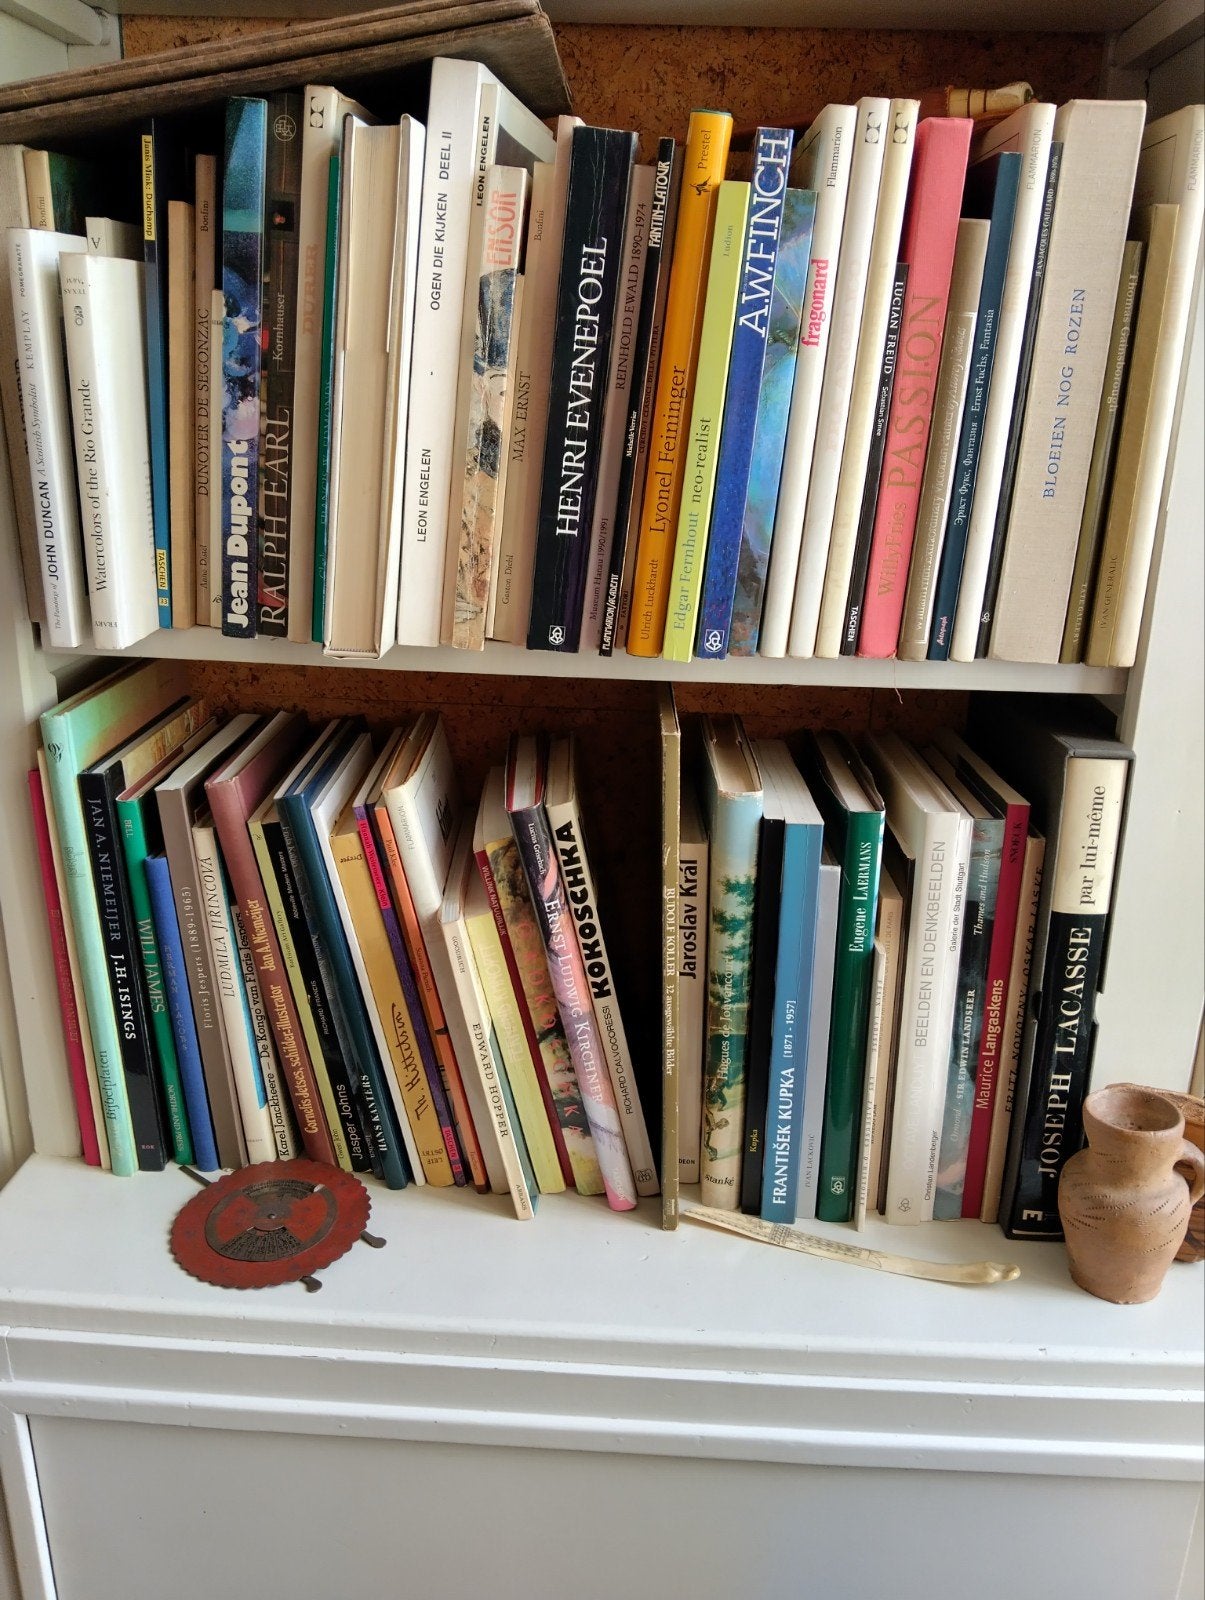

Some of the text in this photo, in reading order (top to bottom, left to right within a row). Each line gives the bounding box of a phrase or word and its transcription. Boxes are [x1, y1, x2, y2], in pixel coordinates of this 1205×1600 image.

[476, 117, 489, 206] LEON ENGELEN
[648, 161, 670, 247] FANTIN-LATOUR
[697, 129, 711, 170] Prestel
[826, 126, 842, 188] Flammarion
[1026, 129, 1042, 190] FLAMMARION
[1187, 129, 1204, 191] FLAMMARION
[430, 131, 452, 310] OGEN DIE KIJKEN DEEL II
[486, 190, 517, 265] ENSOR
[1035, 229, 1050, 277] JEAN-JACQUES
[21, 310, 34, 369] KEMPLAY
[273, 292, 285, 361] Kornhauser
[615, 265, 639, 390] REINHOLD EWALD
[801, 259, 829, 347] fragonard
[883, 282, 904, 374] LUCIAN FREUD
[1107, 273, 1139, 413] Thomas Gainsborough
[197, 309, 209, 496] DUNOYER DE SEGONZAC
[555, 237, 607, 537] HENRI EVENEPOEL
[887, 293, 941, 489] PASSION
[971, 309, 994, 411] Ernst Fuchs, Fantasia
[1043, 289, 1086, 498] BLOEIEN NOG ROZEN
[512, 371, 531, 462] MAX ERNST
[27, 383, 59, 581] JOHN DUNCAN Scottish Symbolist
[78, 379, 108, 591] Watercolors of the Rio Grande
[260, 408, 290, 626] RALPH EARL
[417, 449, 431, 542] LEON ENGELEN
[640, 366, 687, 640] Ulrich Luckhardt Lyonel Feininger
[673, 417, 711, 630] Edgar Fernhout neo-realist
[954, 422, 978, 526] Эрнст Фукс, Фантазия
[158, 552, 167, 588] TASCHEN
[226, 440, 252, 628] Jean Dupont
[589, 517, 608, 620] Museum Hanau 1990/1991
[847, 606, 859, 642] TASCHEN
[386, 840, 396, 852] Paul
[398, 806, 414, 849] FLAMMARION
[852, 842, 872, 900] LAERMANS
[1079, 786, 1106, 905] par lui-même
[87, 799, 136, 1039] JAN A. NIEMEIJER J.H. ISINGS
[197, 857, 235, 997] LUDMILA JIŘINCOVÁ
[481, 865, 507, 936] WILLINK NATUURLIJK
[679, 859, 698, 979] Jaroslav Král
[914, 841, 946, 1047] BEELDEN EN DENKBEELDEN
[973, 849, 991, 935] Thames and Hudson
[137, 919, 164, 1013] WILL JAMES
[181, 886, 213, 1028] Floris Jespers (1889-1965)
[277, 851, 363, 1160] Jasper Johns RICHARD FRANCIS Modern Masters
[528, 823, 603, 1102] Lucius ERNST LUDWIG KIRCHNER
[554, 821, 633, 1115] KOKOSCHKA RICHARD CALVOCORESSI
[665, 888, 676, 1075] RUDOLF Bilder
[240, 952, 290, 1156] Karel Jonckheere De van Floris
[246, 899, 318, 1133] Cornelis Jetses, schilder-illustrator Jan A. Niemeijer
[451, 936, 509, 1138] GOODRICH EDWARD HOPPER
[717, 1023, 731, 1080] Hugues de
[924, 863, 965, 1200] Christian Landenberger Galerie der Stadt Stuttgart
[956, 989, 976, 1099] SIR EDWIN LANDSEER
[976, 979, 1004, 1109] Maurice Langaskens
[1037, 927, 1092, 1178] JOSEPH LACASSE
[100, 1051, 119, 1120] Bijbelplaten
[361, 1074, 388, 1151] HANS KANTERS
[749, 1129, 759, 1152] Kupka
[773, 1068, 795, 1204] FRANTIŠEK KUPKA
[444, 1129, 457, 1158] TASCHEN
